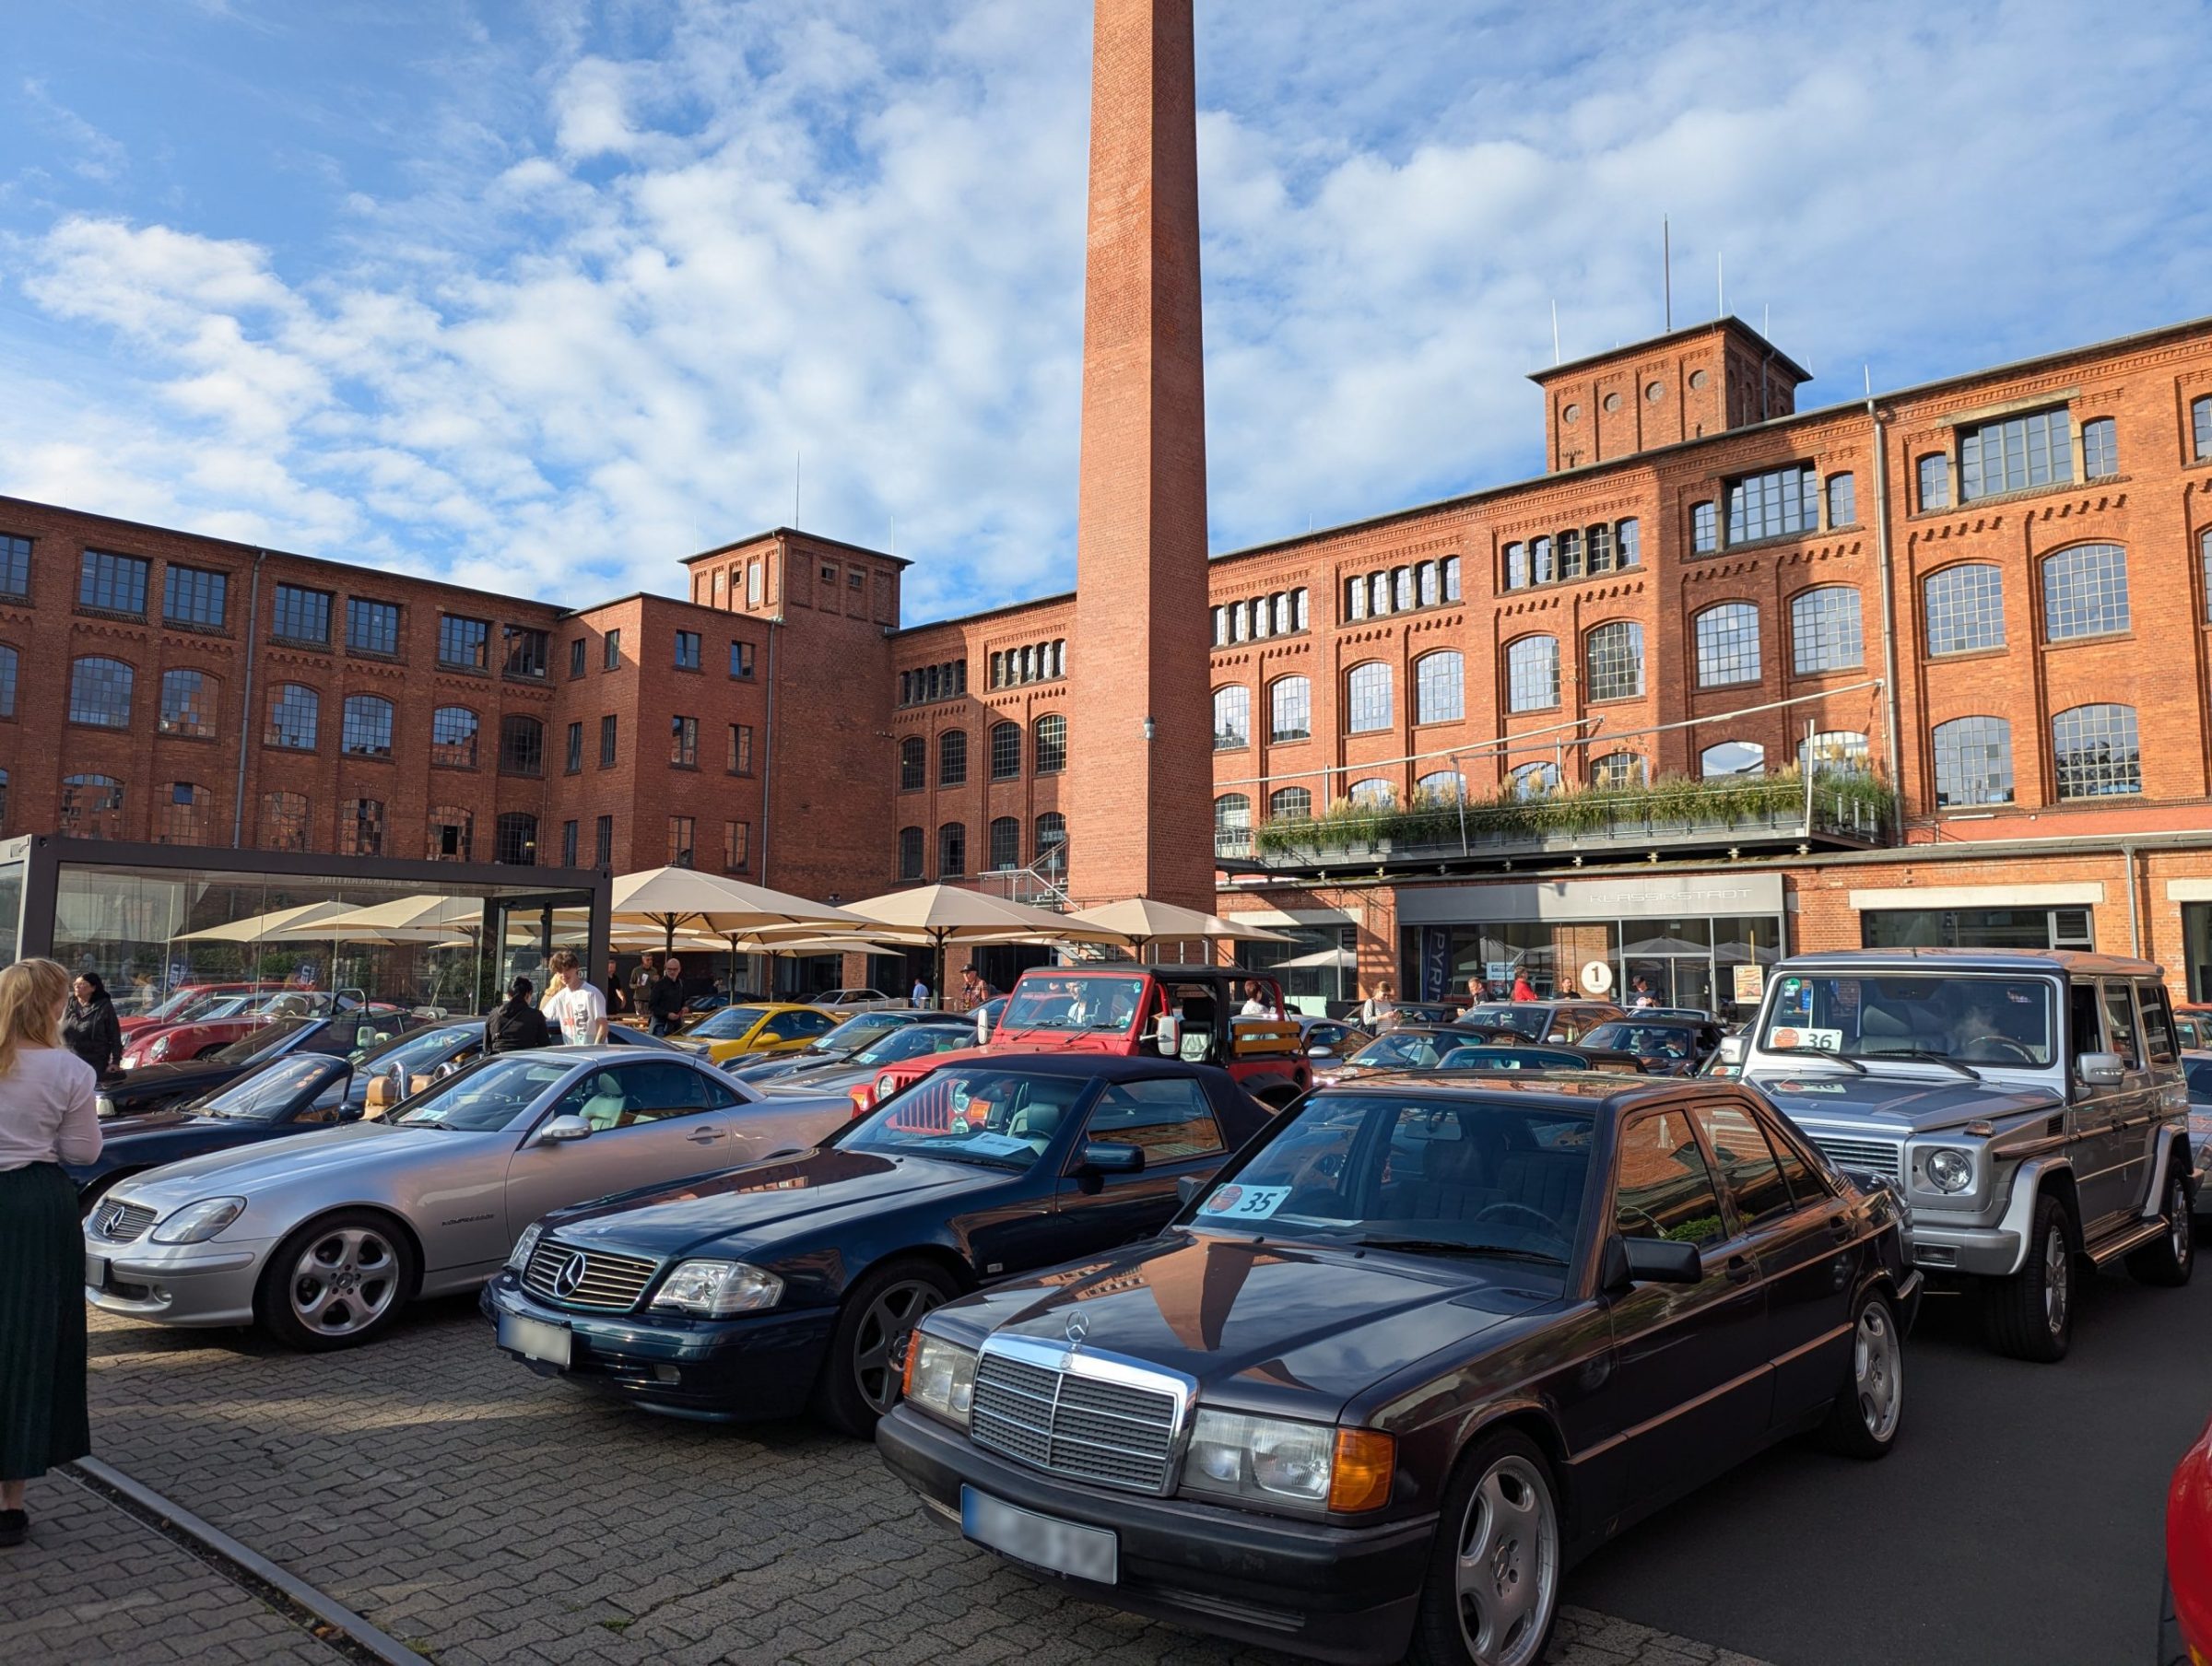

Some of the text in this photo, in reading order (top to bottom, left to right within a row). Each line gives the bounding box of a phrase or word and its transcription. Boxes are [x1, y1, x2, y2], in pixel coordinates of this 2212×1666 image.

[1590, 889, 1753, 903] KLASSIKSTADT
[1591, 965, 1599, 982] 1
[1807, 1033, 1832, 1049] 36
[1240, 1191, 1277, 1213] 35
